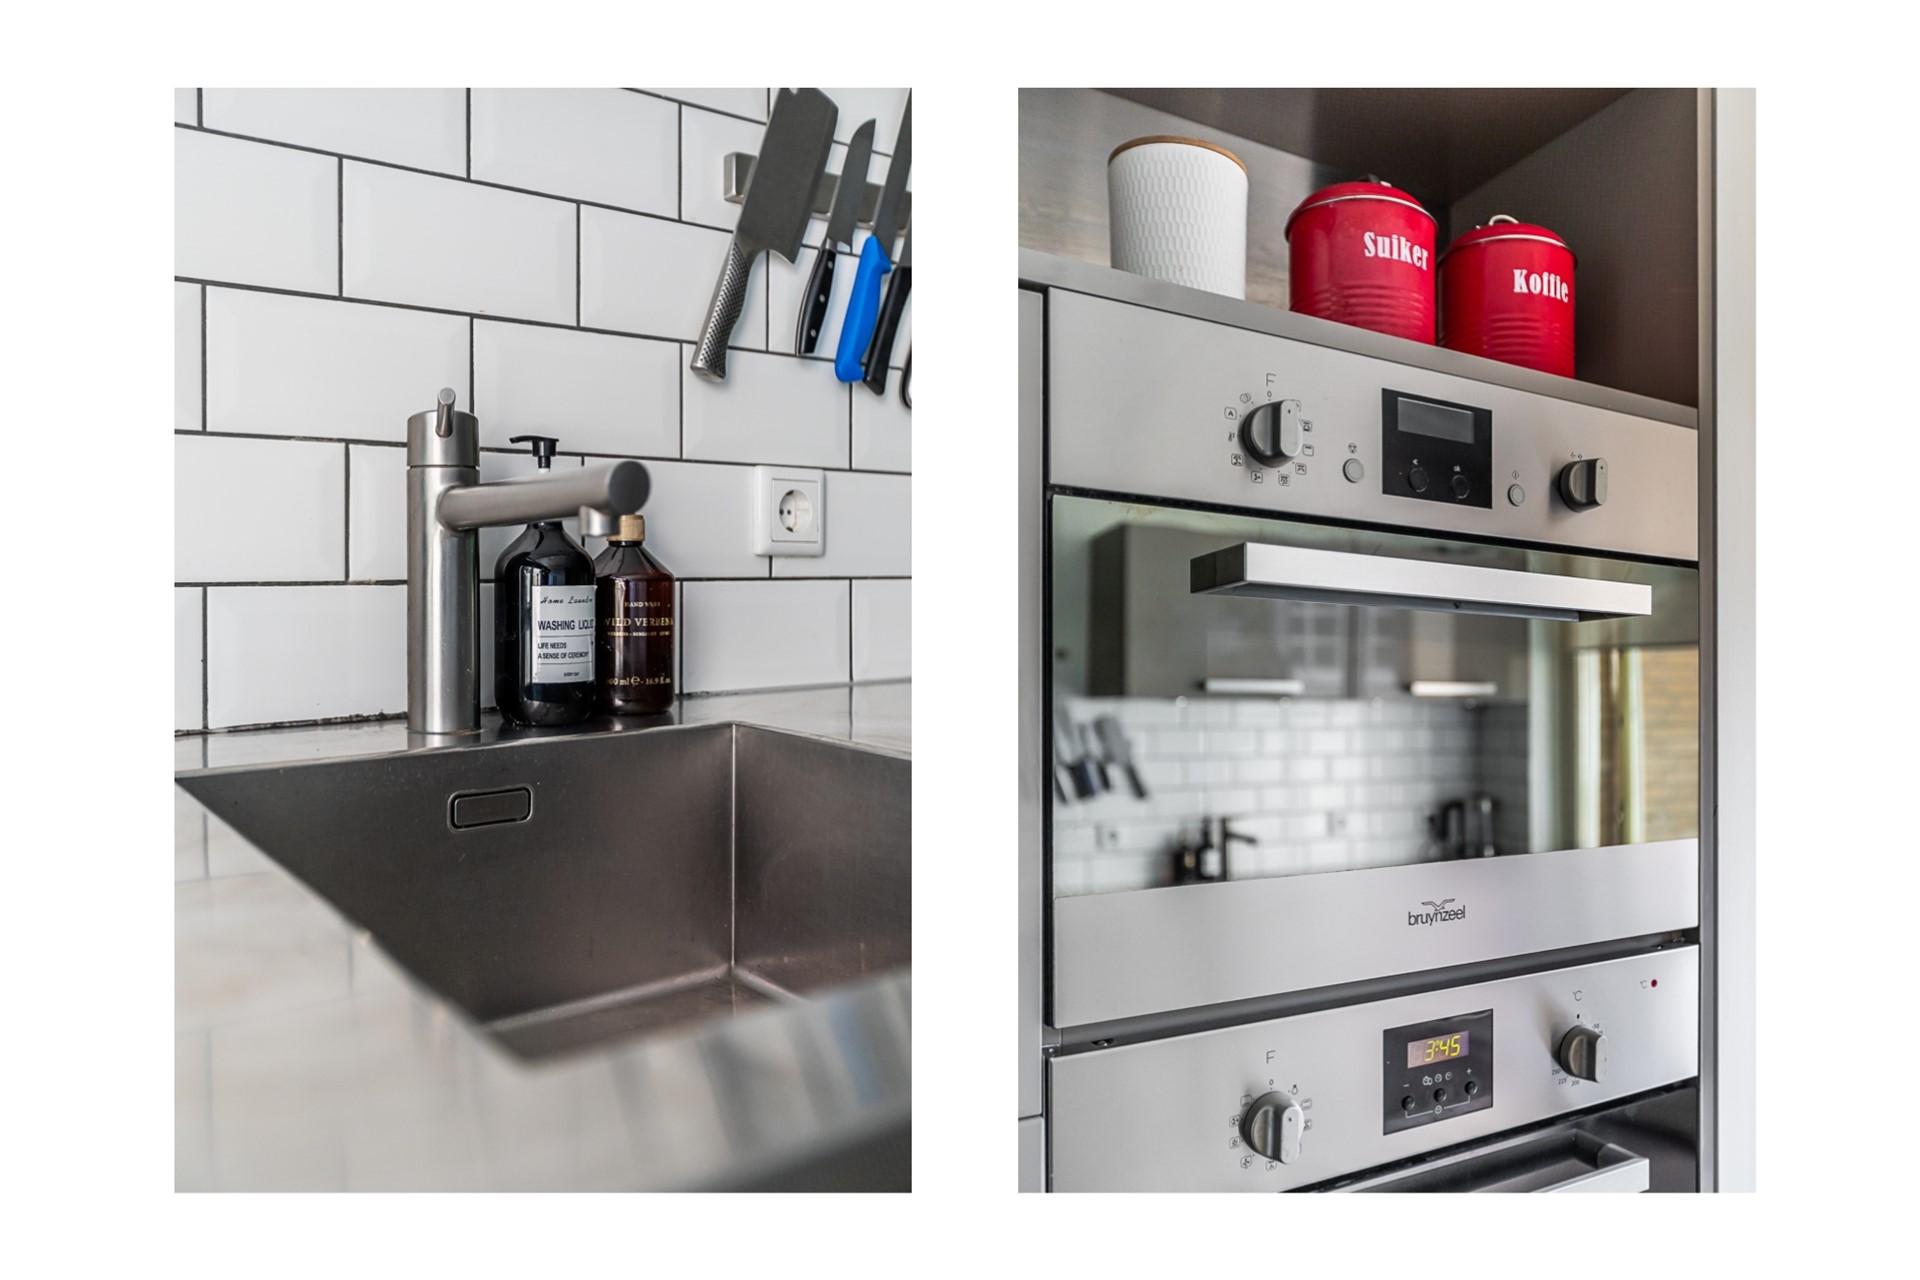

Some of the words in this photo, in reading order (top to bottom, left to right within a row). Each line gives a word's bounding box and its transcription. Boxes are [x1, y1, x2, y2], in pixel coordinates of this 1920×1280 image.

[1363, 231, 1429, 271] Suiker
[1513, 268, 1569, 303] Koffie
[1266, 372, 1277, 387] F
[538, 620, 576, 631] WASHING
[538, 642, 549, 650] LIFE
[550, 642, 567, 650] NEEDS
[538, 652, 542, 660] A
[543, 652, 560, 660] SENSE
[560, 652, 567, 660] OF
[1408, 905, 1466, 926] bruynzeel
[1266, 1050, 1276, 1064] F
